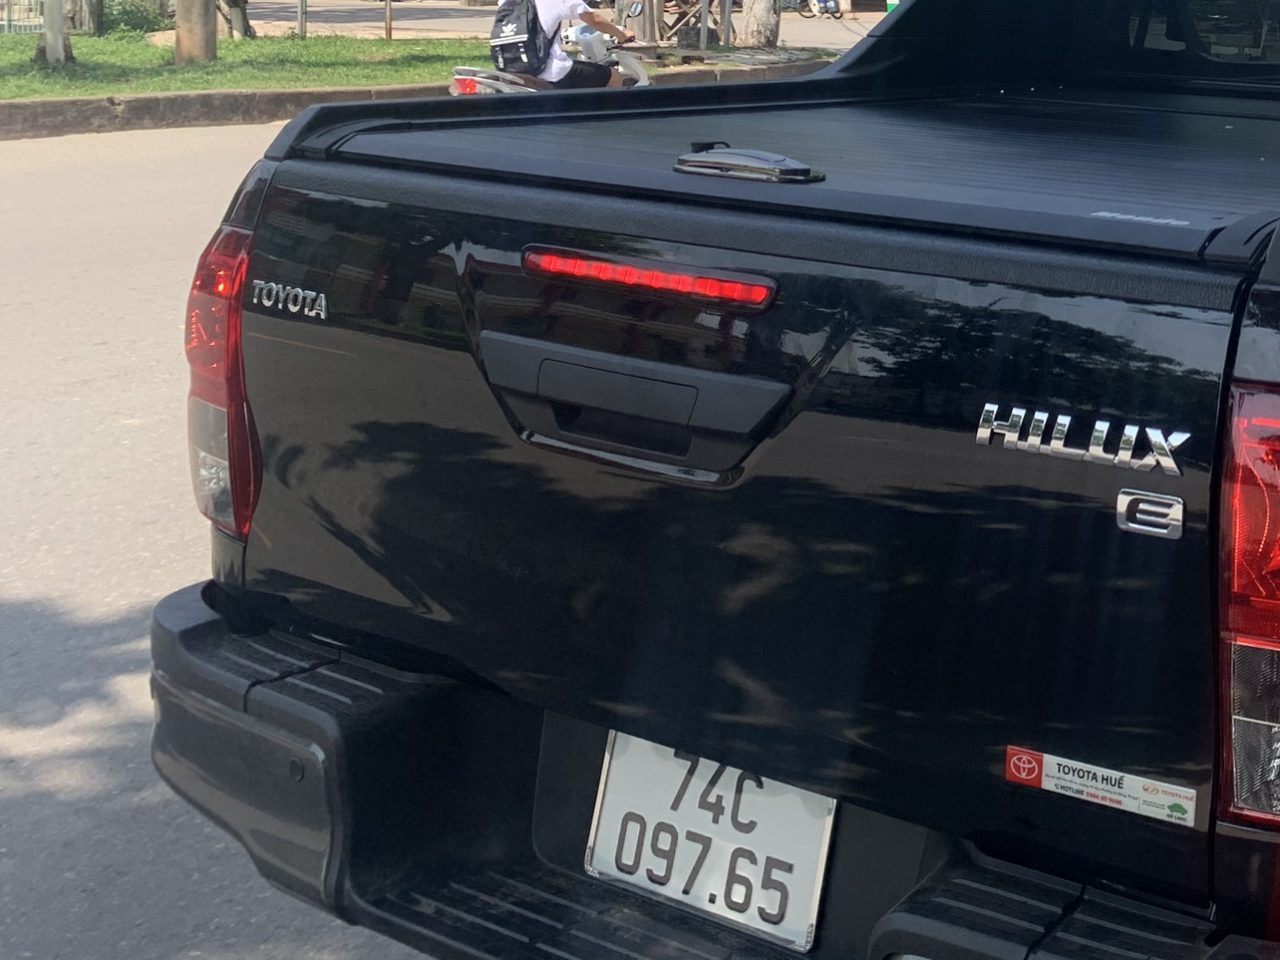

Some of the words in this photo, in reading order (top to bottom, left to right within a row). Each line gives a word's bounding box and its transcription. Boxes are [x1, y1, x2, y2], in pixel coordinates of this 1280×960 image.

[252, 280, 327, 319] TOYOTA
[976, 403, 1191, 476] HILUX
[670, 748, 764, 834] 74C
[1056, 763, 1098, 783] TOYOTA
[614, 811, 795, 926] 097.65
